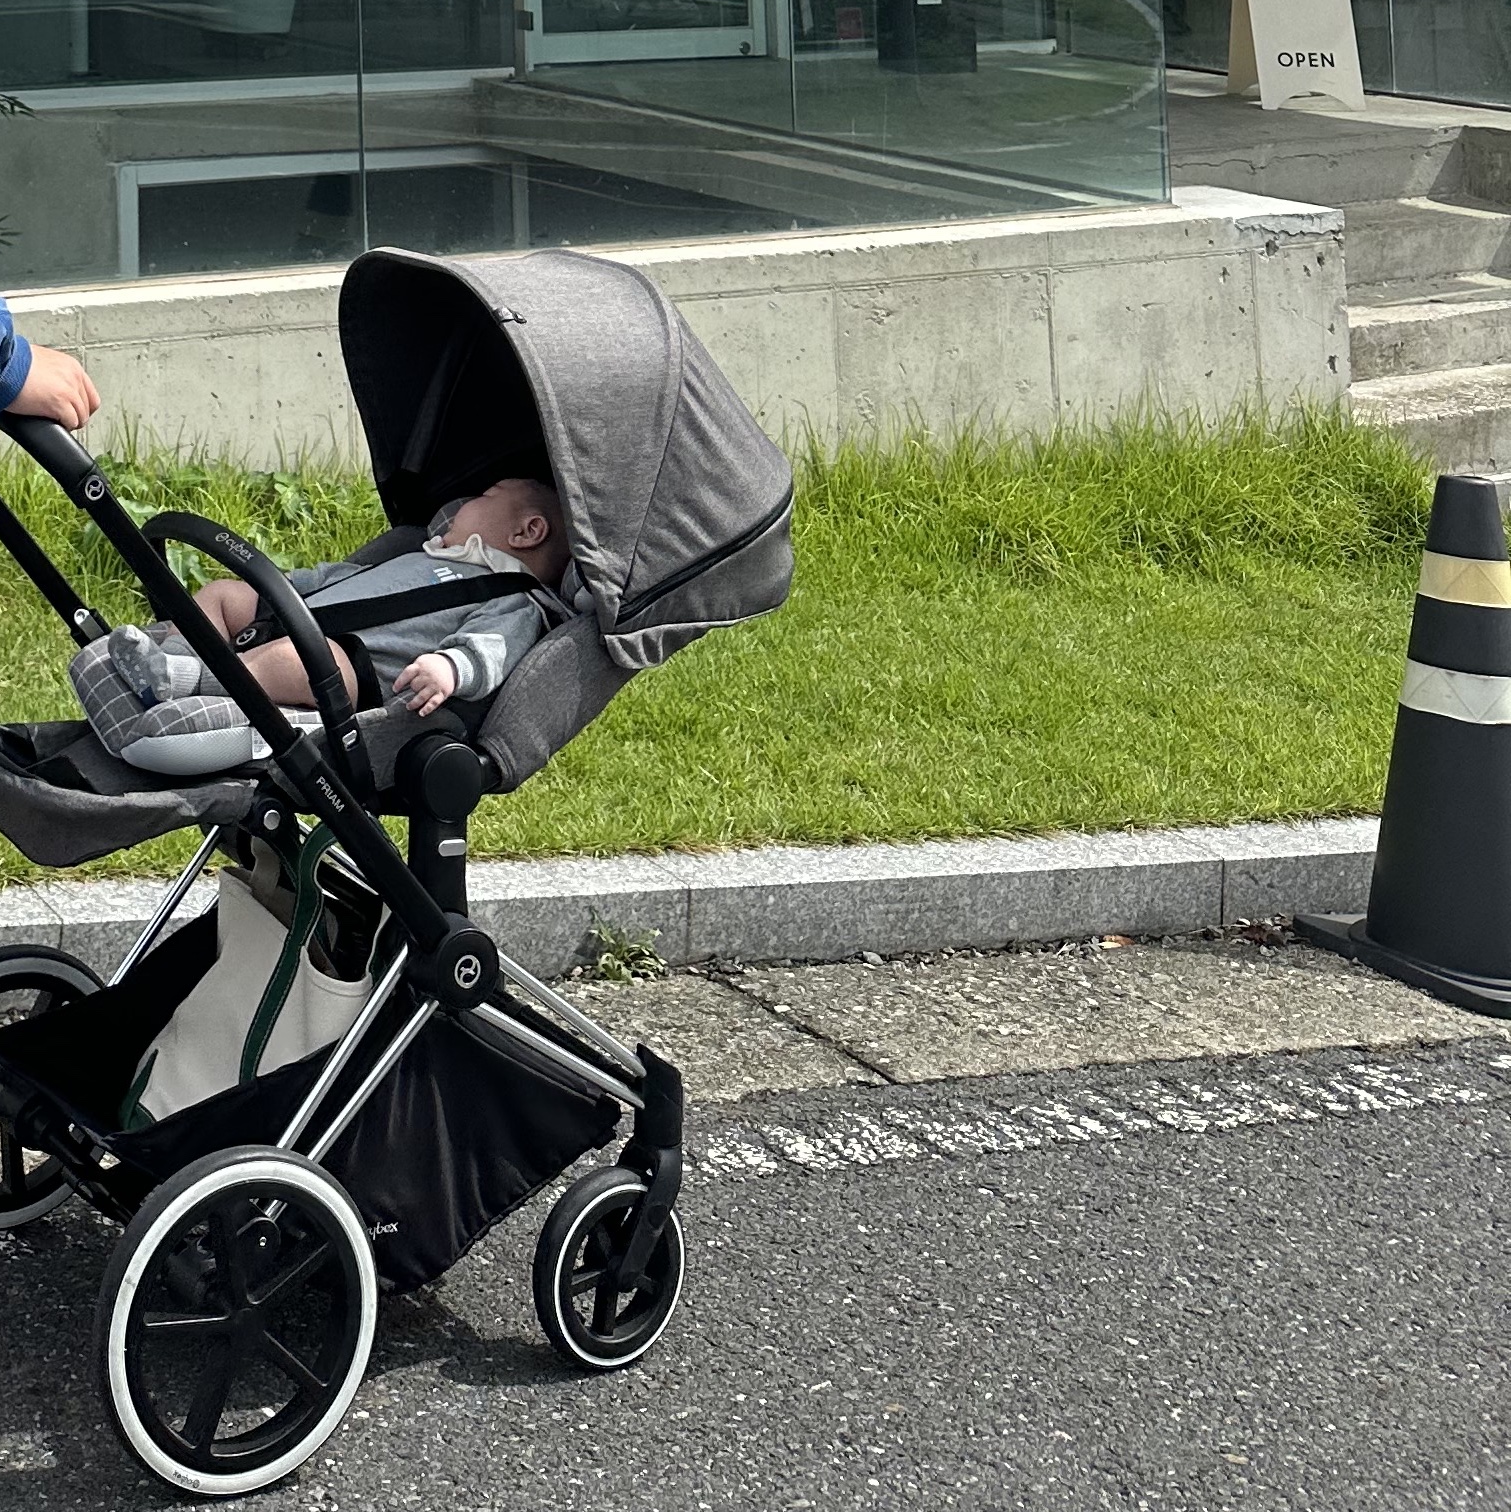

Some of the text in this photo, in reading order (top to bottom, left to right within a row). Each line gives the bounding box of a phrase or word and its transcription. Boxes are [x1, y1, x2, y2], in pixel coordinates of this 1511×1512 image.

[1277, 51, 1335, 68] OPEN
[225, 538, 254, 561] cybex
[315, 775, 345, 813] PRIAM
[366, 1221, 399, 1241] ybex
